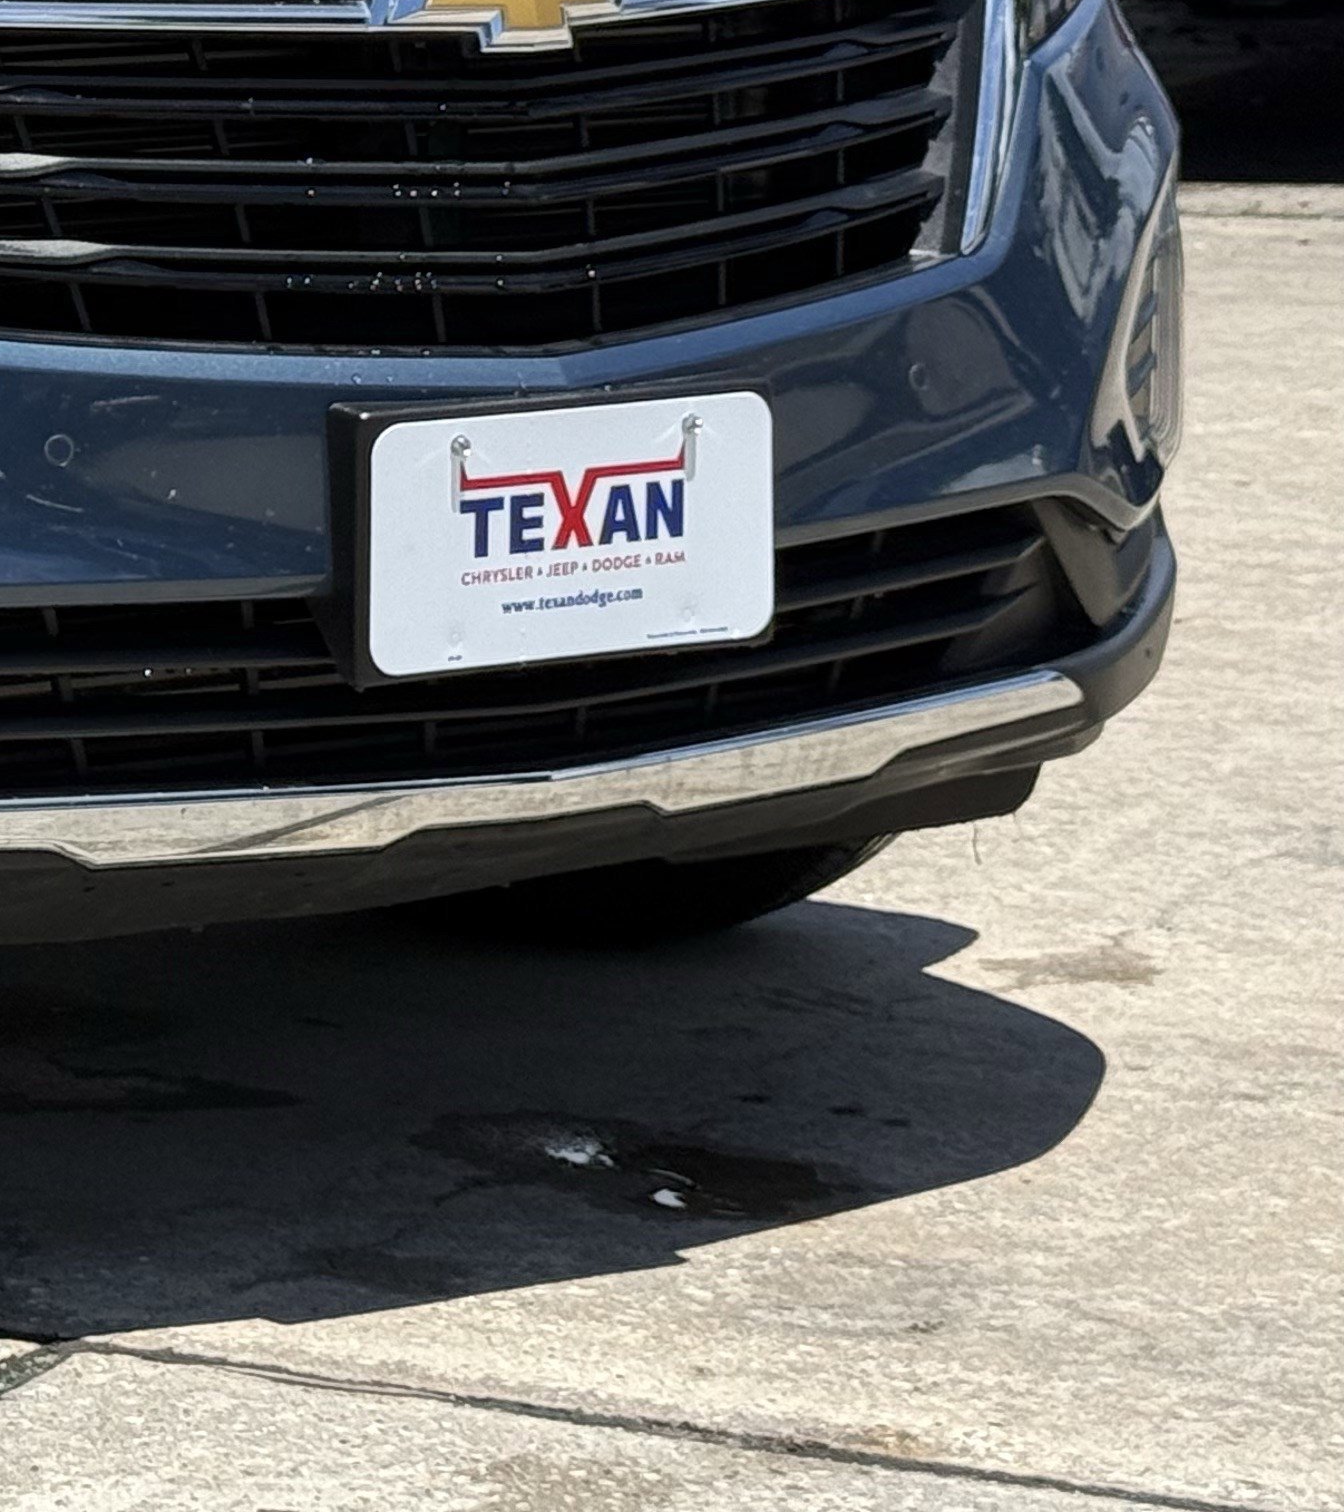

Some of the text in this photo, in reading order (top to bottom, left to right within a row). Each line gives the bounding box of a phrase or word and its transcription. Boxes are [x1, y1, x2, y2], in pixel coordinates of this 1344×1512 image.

[459, 462, 686, 558] TEXAN
[460, 550, 687, 587] CHRYSLER JEEP DODGE RAM
[500, 587, 643, 615] www.texandodge.com
